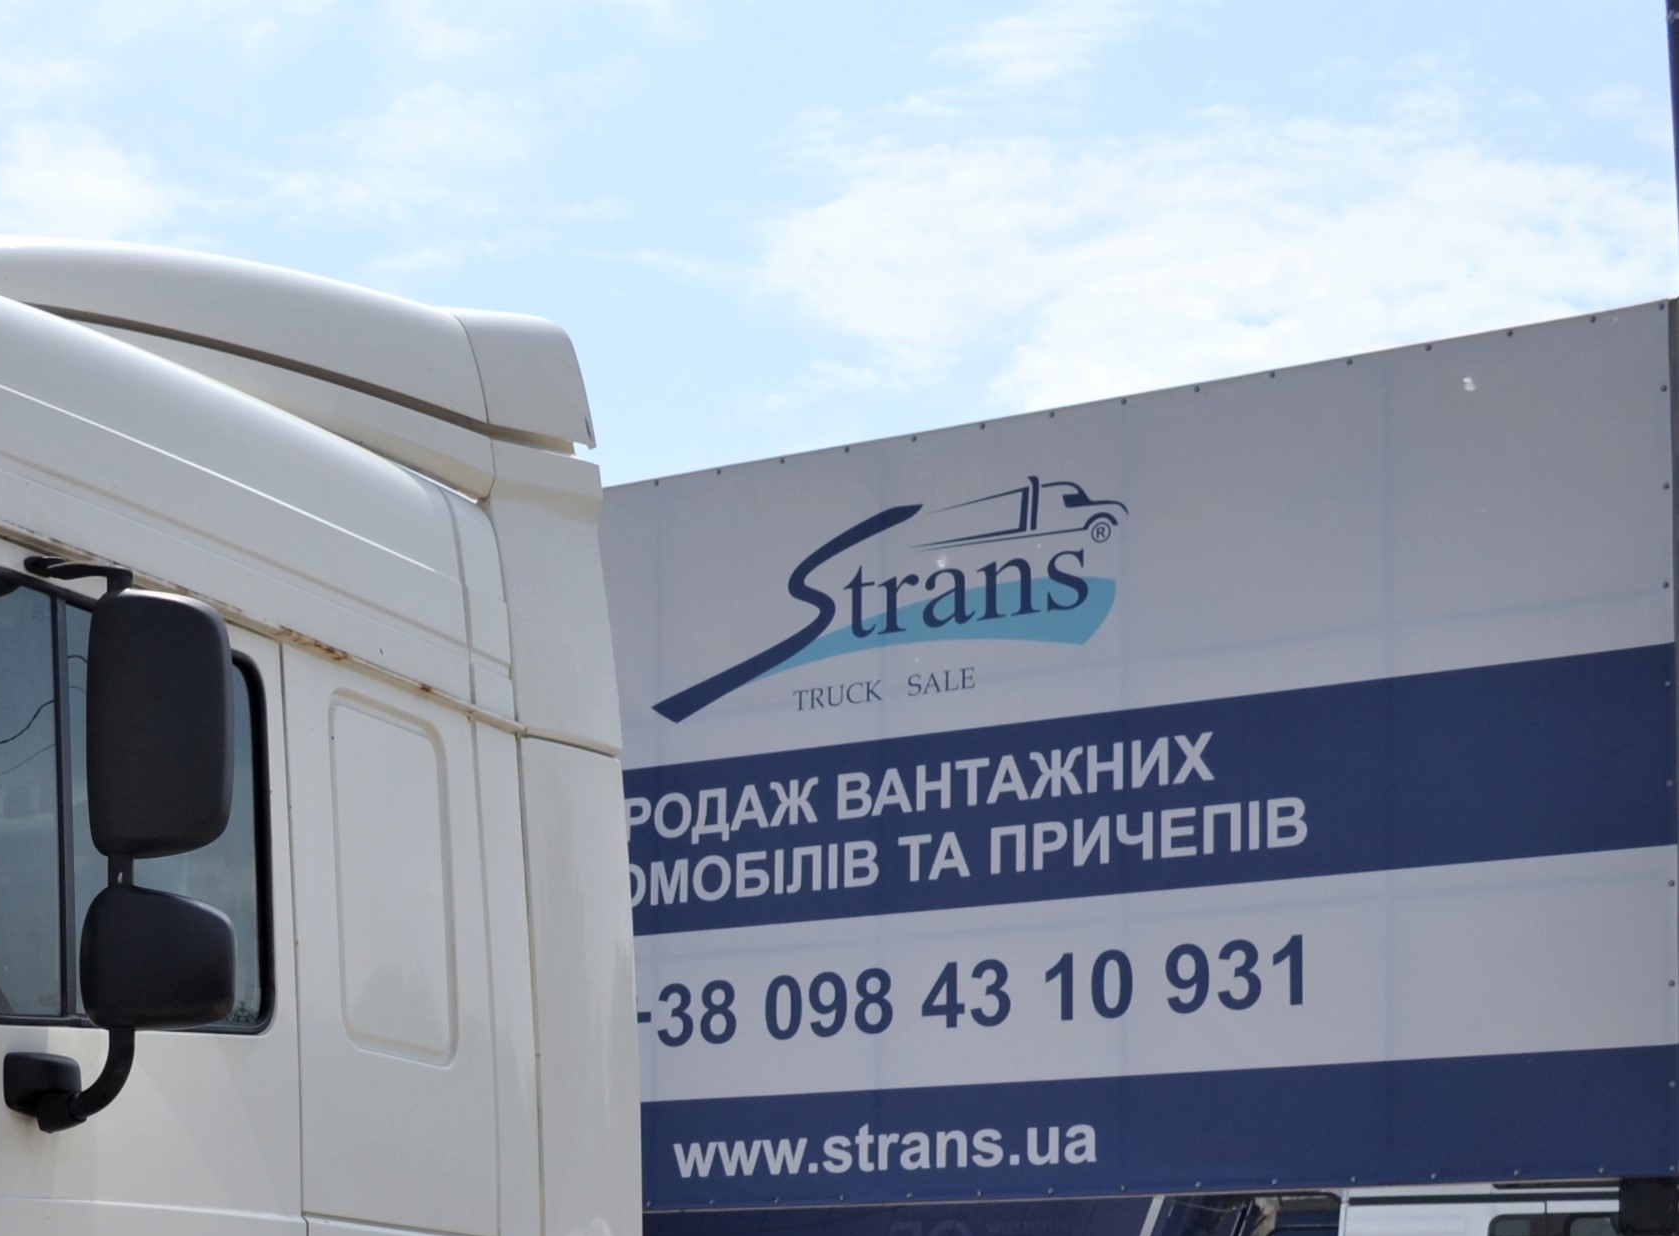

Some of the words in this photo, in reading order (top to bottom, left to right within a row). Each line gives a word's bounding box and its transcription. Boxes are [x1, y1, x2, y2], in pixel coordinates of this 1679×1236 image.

[794, 679, 883, 712] TRUCK
[907, 666, 976, 697] SALE
[837, 731, 1215, 821] ВАНТАЖНИХ
[898, 831, 970, 884] ТА
[989, 796, 1309, 875] ПРИЧЕПІВ
[764, 967, 894, 1041] 098
[922, 959, 1012, 1029] 43
[1045, 949, 1133, 1023] 10
[1164, 934, 1305, 1015] 931
[673, 1124, 1097, 1179] www.strans.ua
